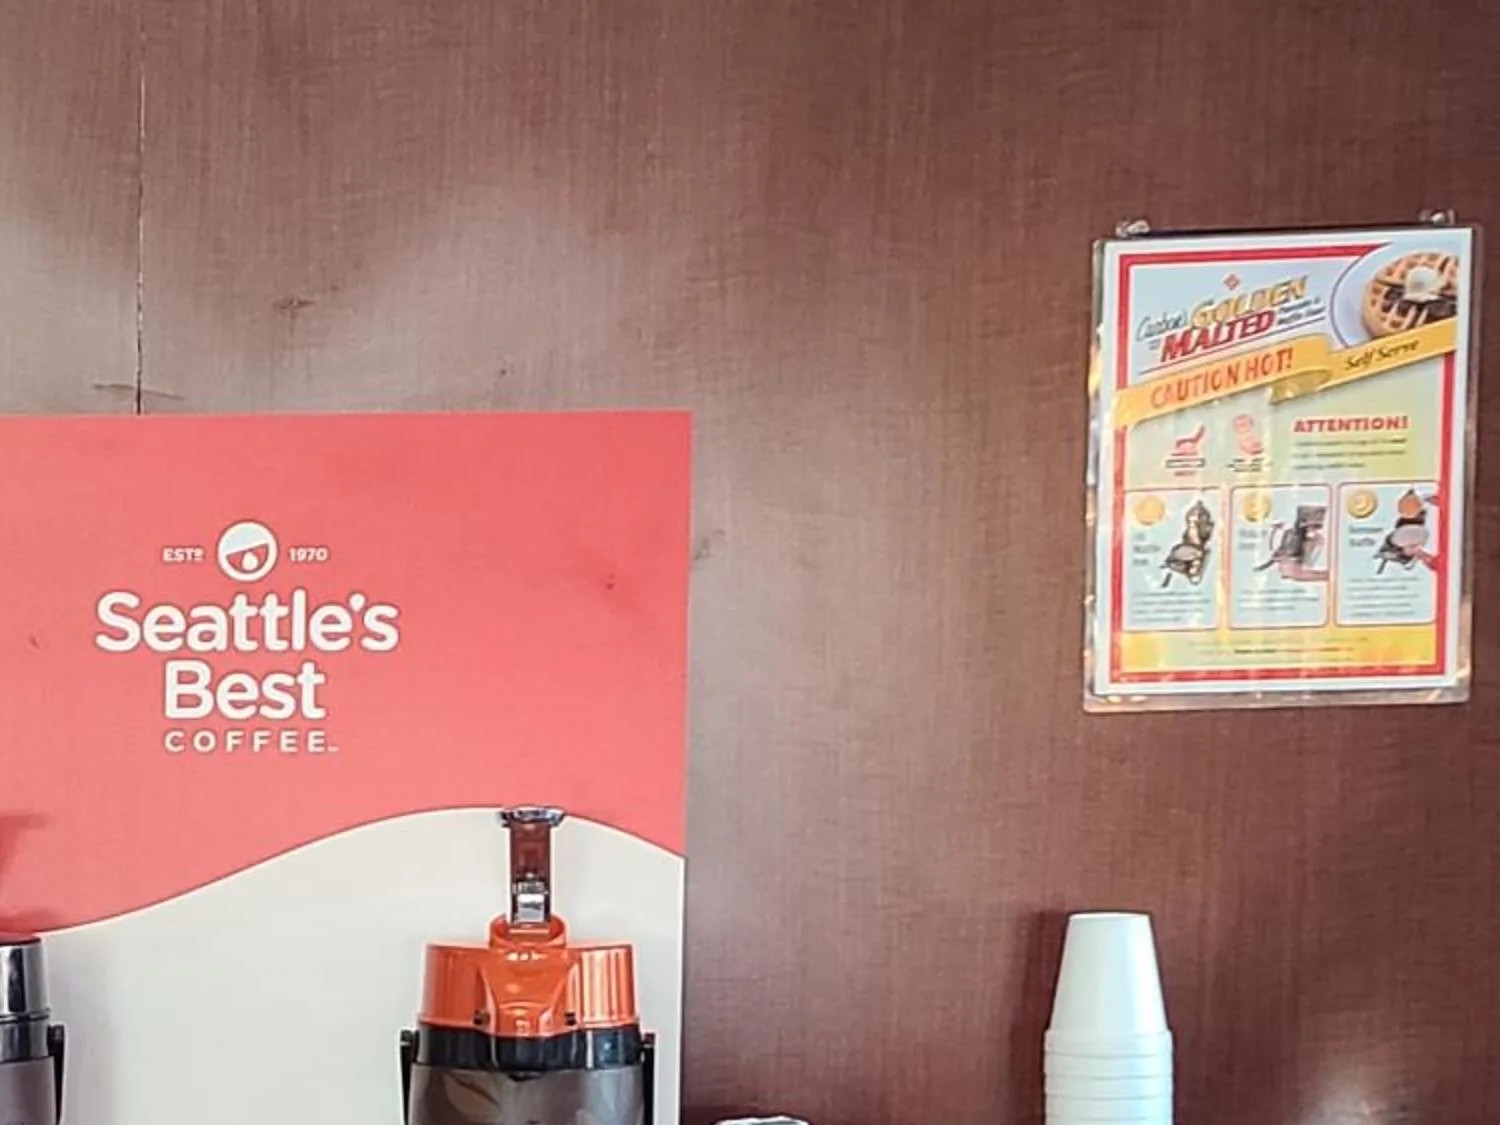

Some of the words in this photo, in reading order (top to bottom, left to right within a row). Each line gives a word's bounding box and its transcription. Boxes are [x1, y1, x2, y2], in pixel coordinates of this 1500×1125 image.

[1191, 275, 1308, 328] GOLDEN
[1160, 310, 1275, 362] MALTED
[1346, 353, 1373, 370] Self
[1375, 340, 1419, 361] Serve
[1151, 362, 1240, 409] CAUTION
[1245, 348, 1294, 382] HOT!
[1293, 415, 1408, 432] ATTENTION!
[289, 548, 327, 561] 1970
[96, 588, 399, 652] Seattle's
[165, 659, 326, 720] Best
[164, 731, 325, 752] COFFEE
